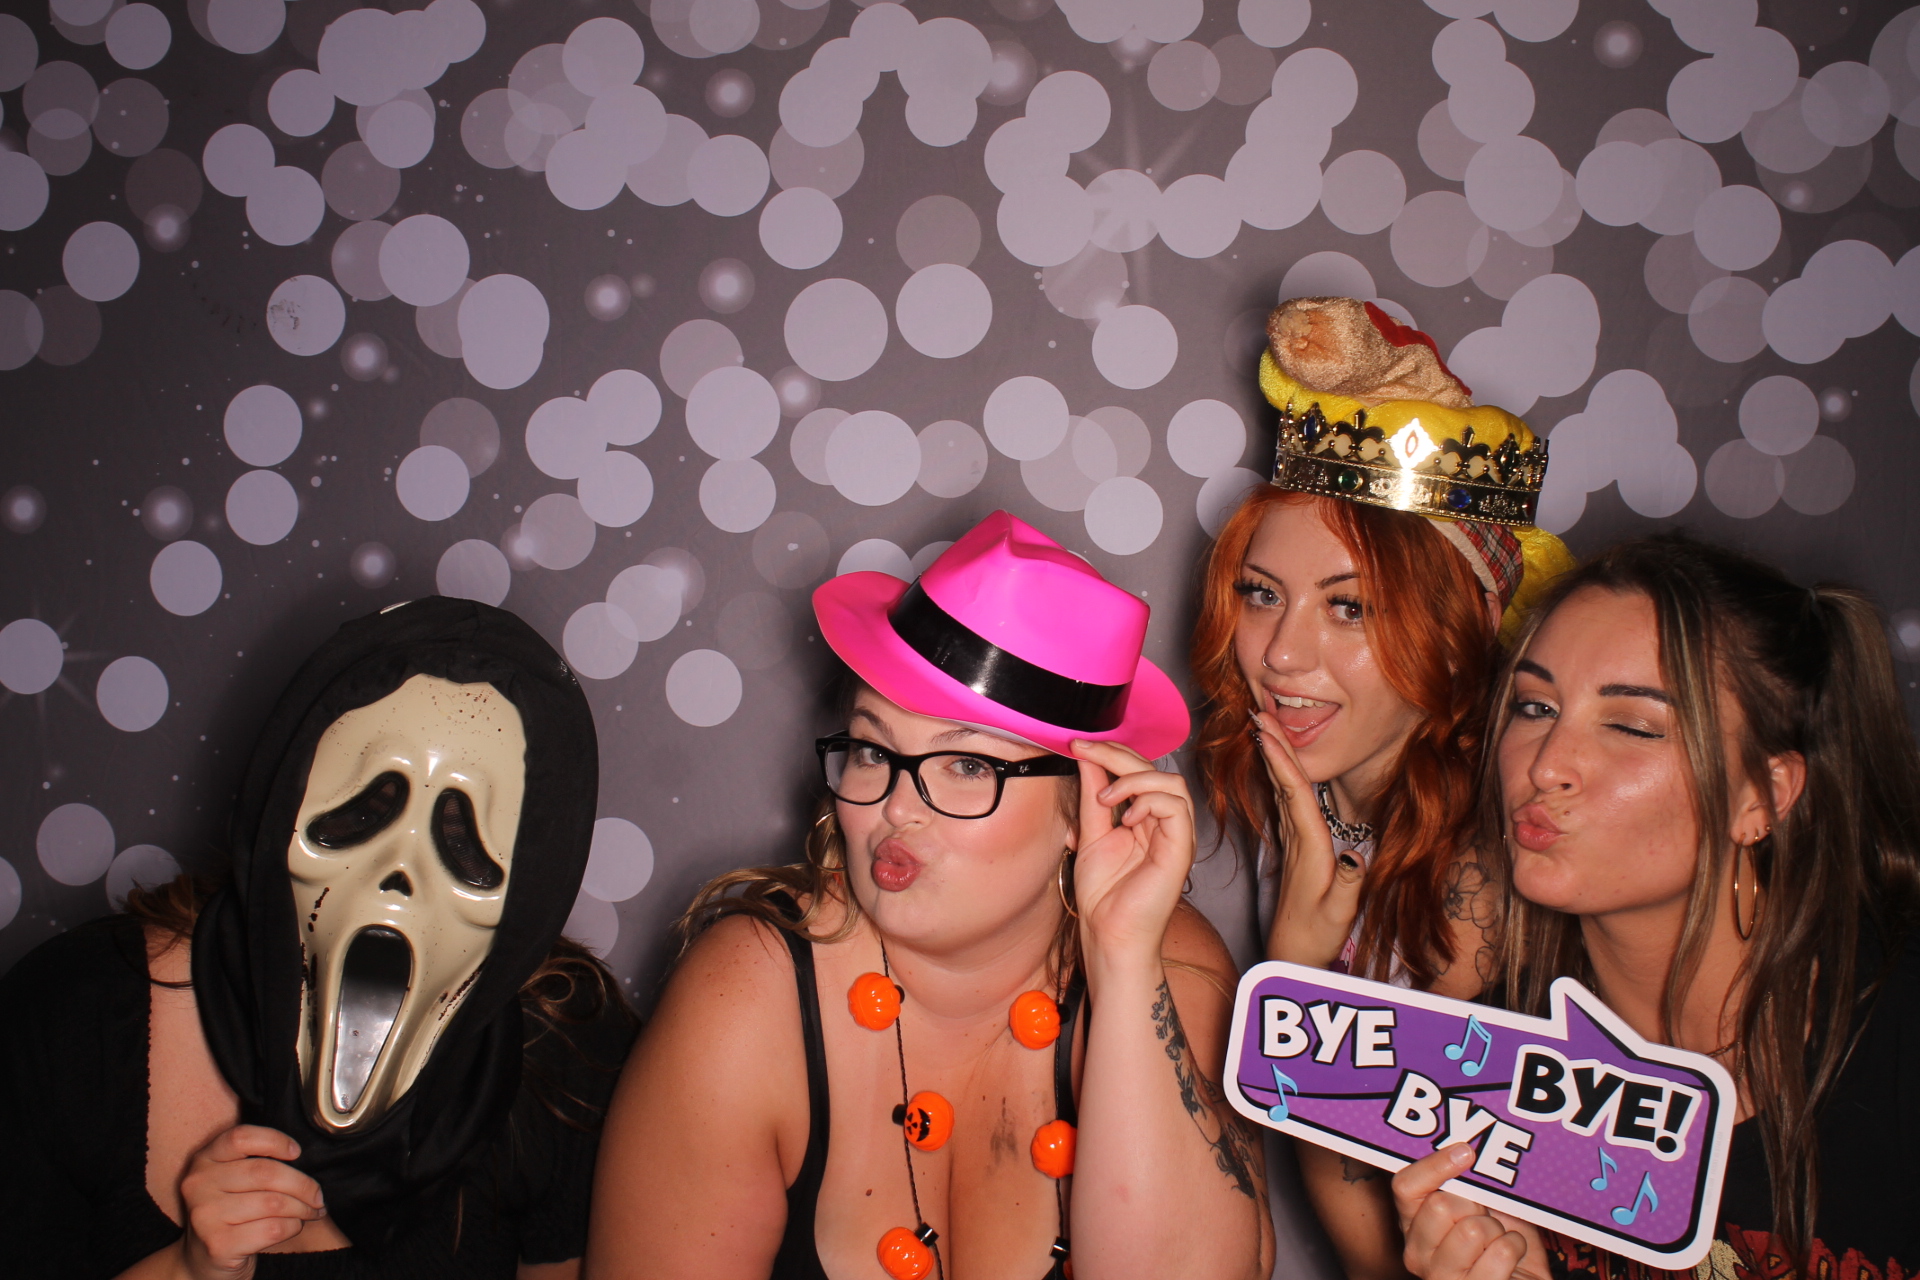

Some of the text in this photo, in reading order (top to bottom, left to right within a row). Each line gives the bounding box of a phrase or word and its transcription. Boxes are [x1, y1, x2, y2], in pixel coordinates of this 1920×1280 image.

[1261, 996, 1396, 1068] BYE
[1385, 1070, 1534, 1186] BYE
[1514, 1052, 1694, 1154] BYE!
